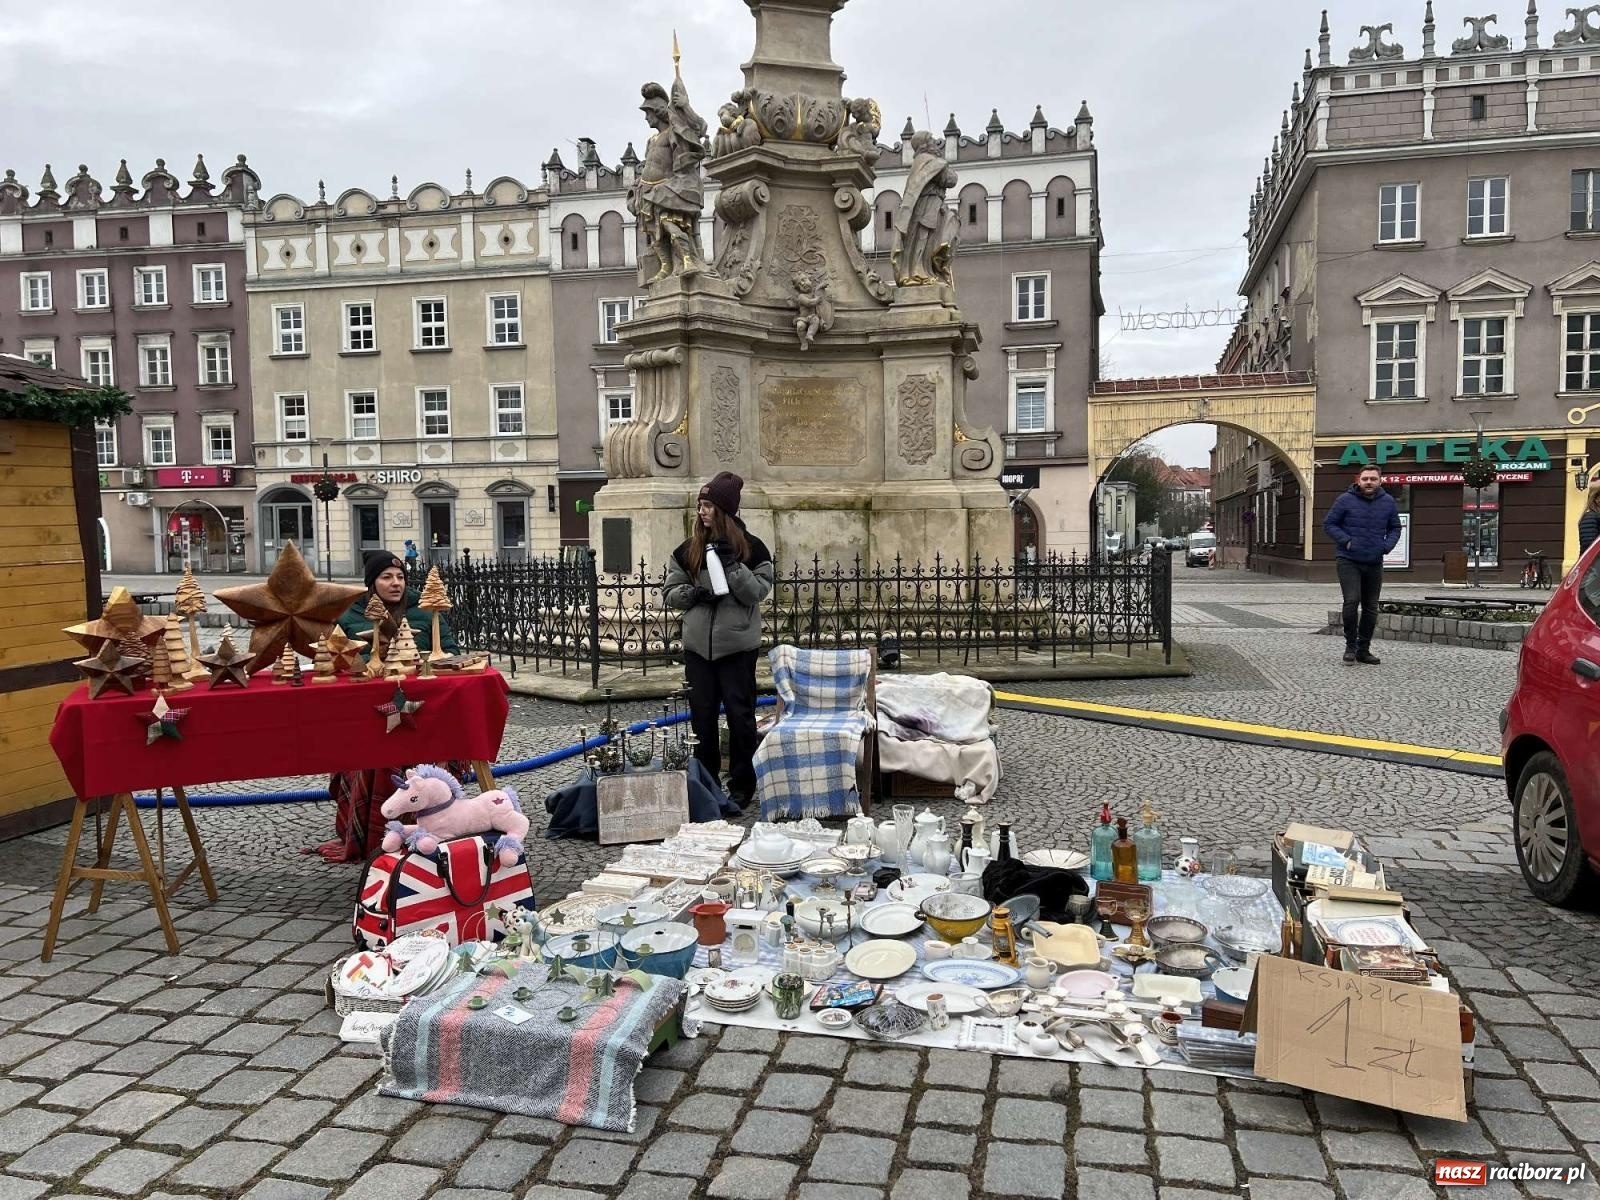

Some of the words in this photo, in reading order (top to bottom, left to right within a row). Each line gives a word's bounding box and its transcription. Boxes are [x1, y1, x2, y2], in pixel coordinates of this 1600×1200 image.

[1338, 437, 1550, 465] APTEKA
[1502, 461, 1547, 471] RÓŻAMI
[377, 470, 421, 483] SHIRO
[1405, 474, 1448, 483] CENTRUM
[1307, 996, 1366, 1073] 1
